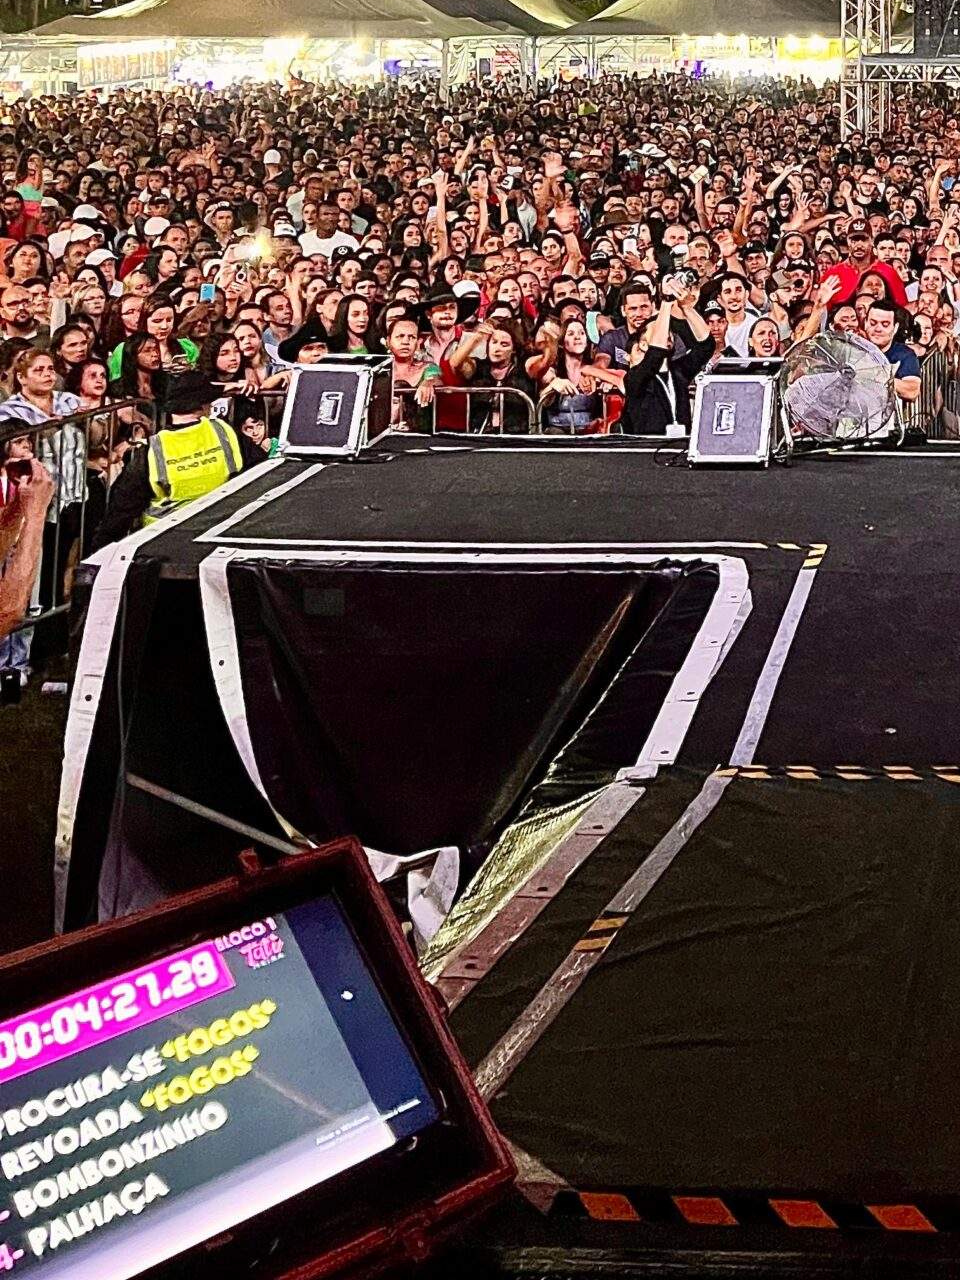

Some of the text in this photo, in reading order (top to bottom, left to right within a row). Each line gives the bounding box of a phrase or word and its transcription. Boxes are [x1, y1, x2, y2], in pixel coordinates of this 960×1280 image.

[214, 916, 277, 952] BLOCO 1
[0, 1046, 167, 1141] ROCURA-SE
[0, 1099, 144, 1181] REVOADA
[13, 1101, 229, 1218] BOMBONZINHO
[27, 1172, 171, 1257] PALHAÇA
